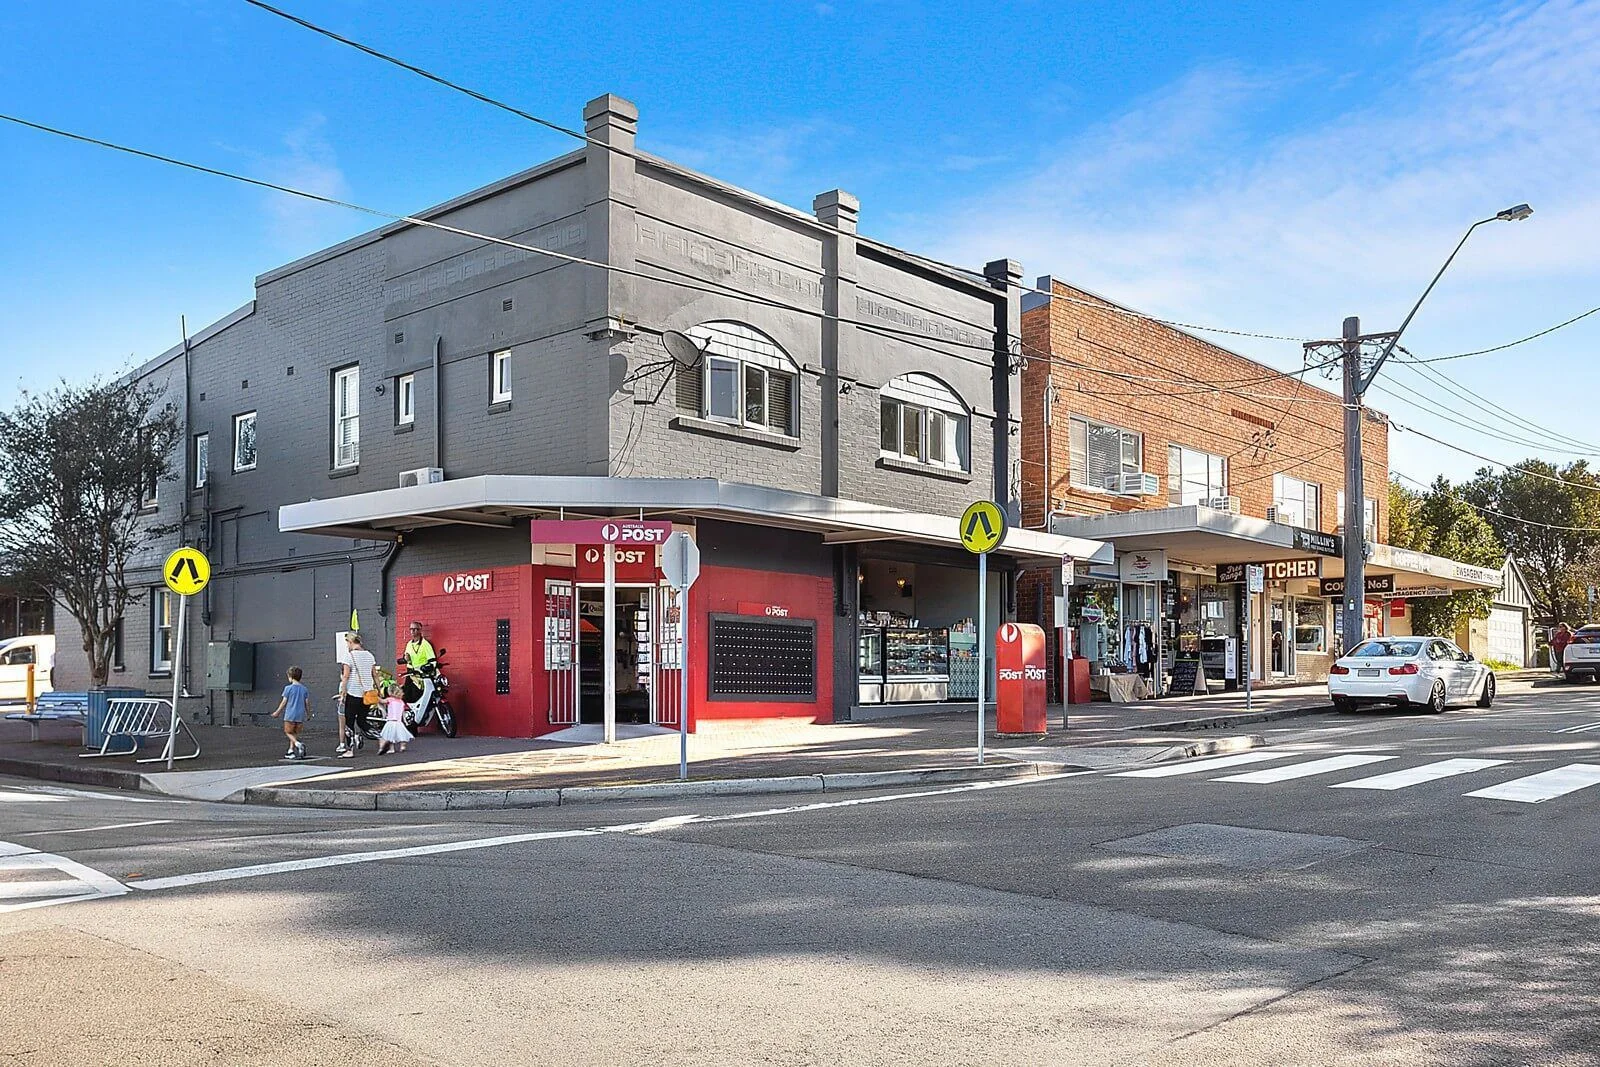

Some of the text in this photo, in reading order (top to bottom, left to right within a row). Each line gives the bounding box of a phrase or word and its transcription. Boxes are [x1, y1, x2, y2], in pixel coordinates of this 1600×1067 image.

[622, 529, 664, 541] POST
[603, 551, 646, 563] OST
[1262, 559, 1317, 579] TCHER
[456, 573, 489, 592] POST
[1367, 579, 1389, 589] No5
[771, 608, 788, 617] POST
[999, 670, 1023, 680] POST
[1025, 669, 1046, 679] POST
